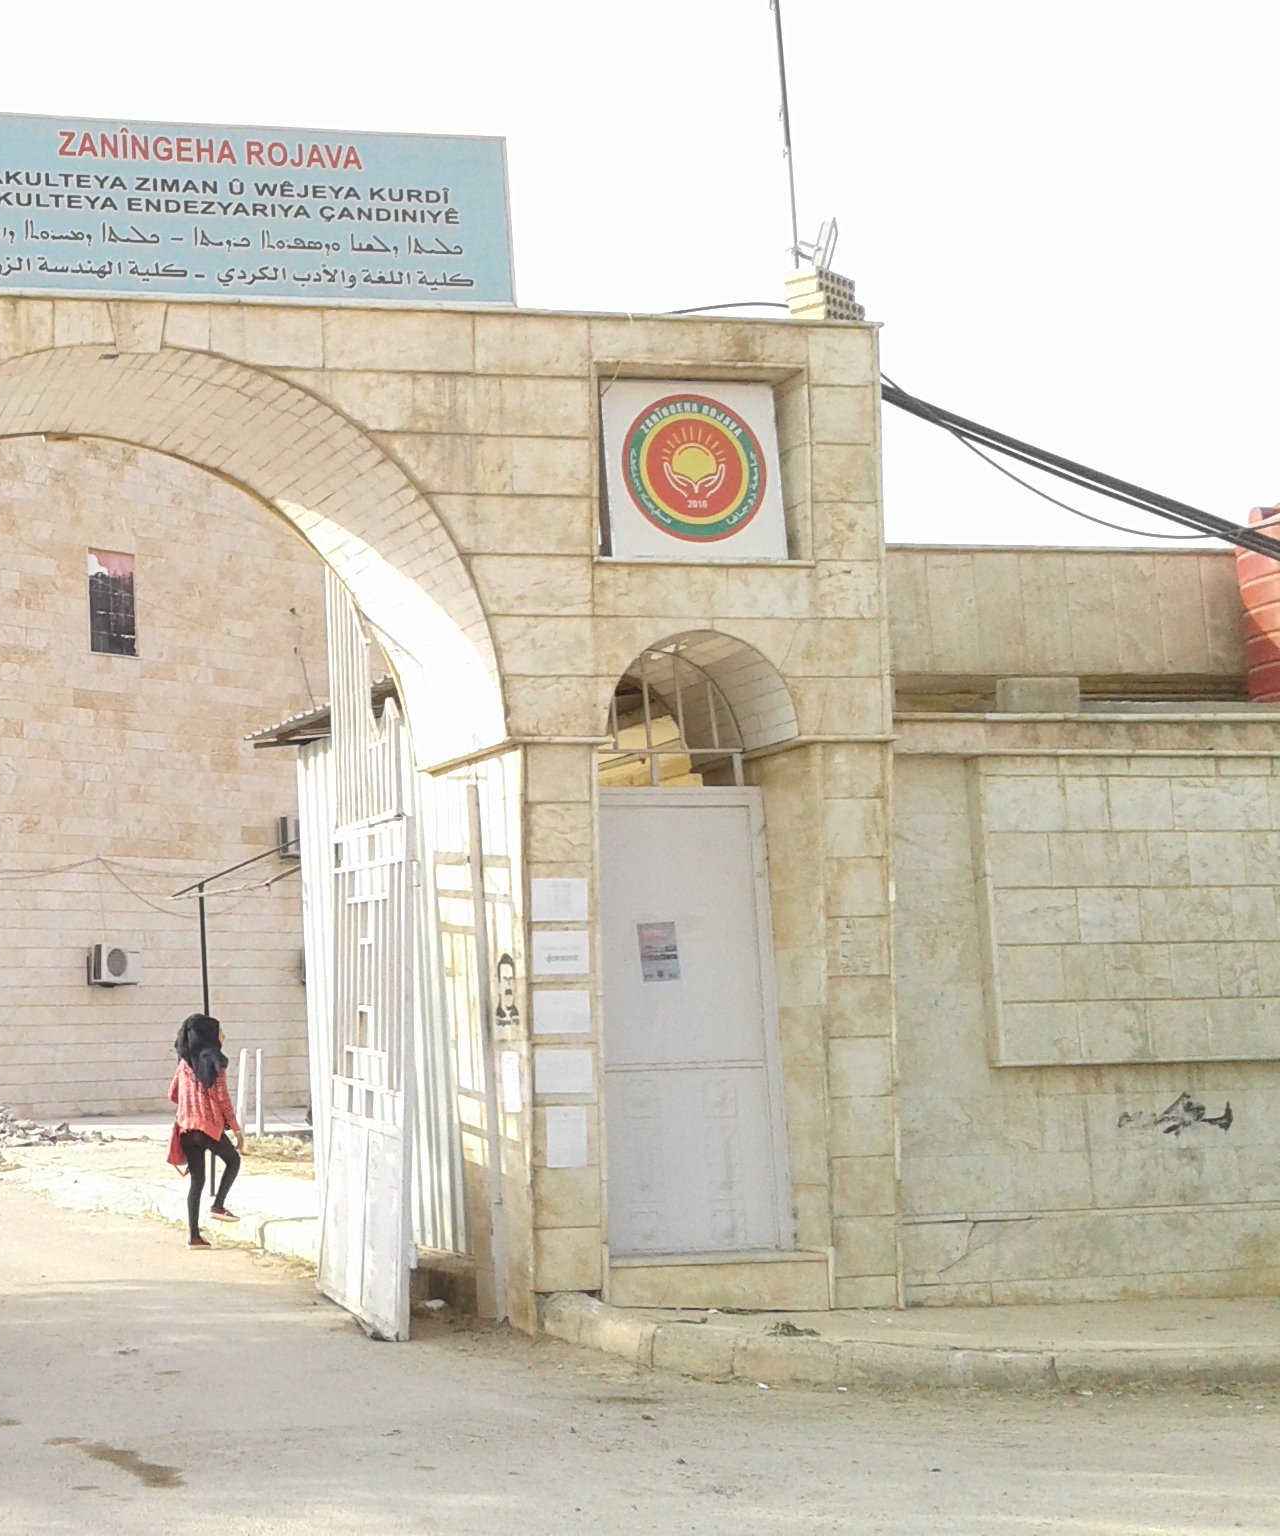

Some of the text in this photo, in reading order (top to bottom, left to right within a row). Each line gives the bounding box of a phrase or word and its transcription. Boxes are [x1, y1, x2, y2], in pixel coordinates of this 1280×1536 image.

[58, 128, 363, 170] ZANÎNGEHA ROJAVA
[135, 177, 218, 195] ZIMAN
[229, 178, 244, 196] Û
[254, 181, 361, 200] WÊJEYA
[369, 187, 450, 205] KURDÎ
[127, 197, 311, 219] ENDEZYARIYA
[320, 205, 461, 225] ÇANDINIYÊ
[38, 257, 122, 280] الهندسة
[128, 261, 188, 281] كلية
[217, 266, 287, 287] الكردي
[293, 262, 357, 289] والأدب
[362, 268, 411, 286] اللغة
[418, 270, 474, 291] كلية
[687, 499, 708, 509] 2016
